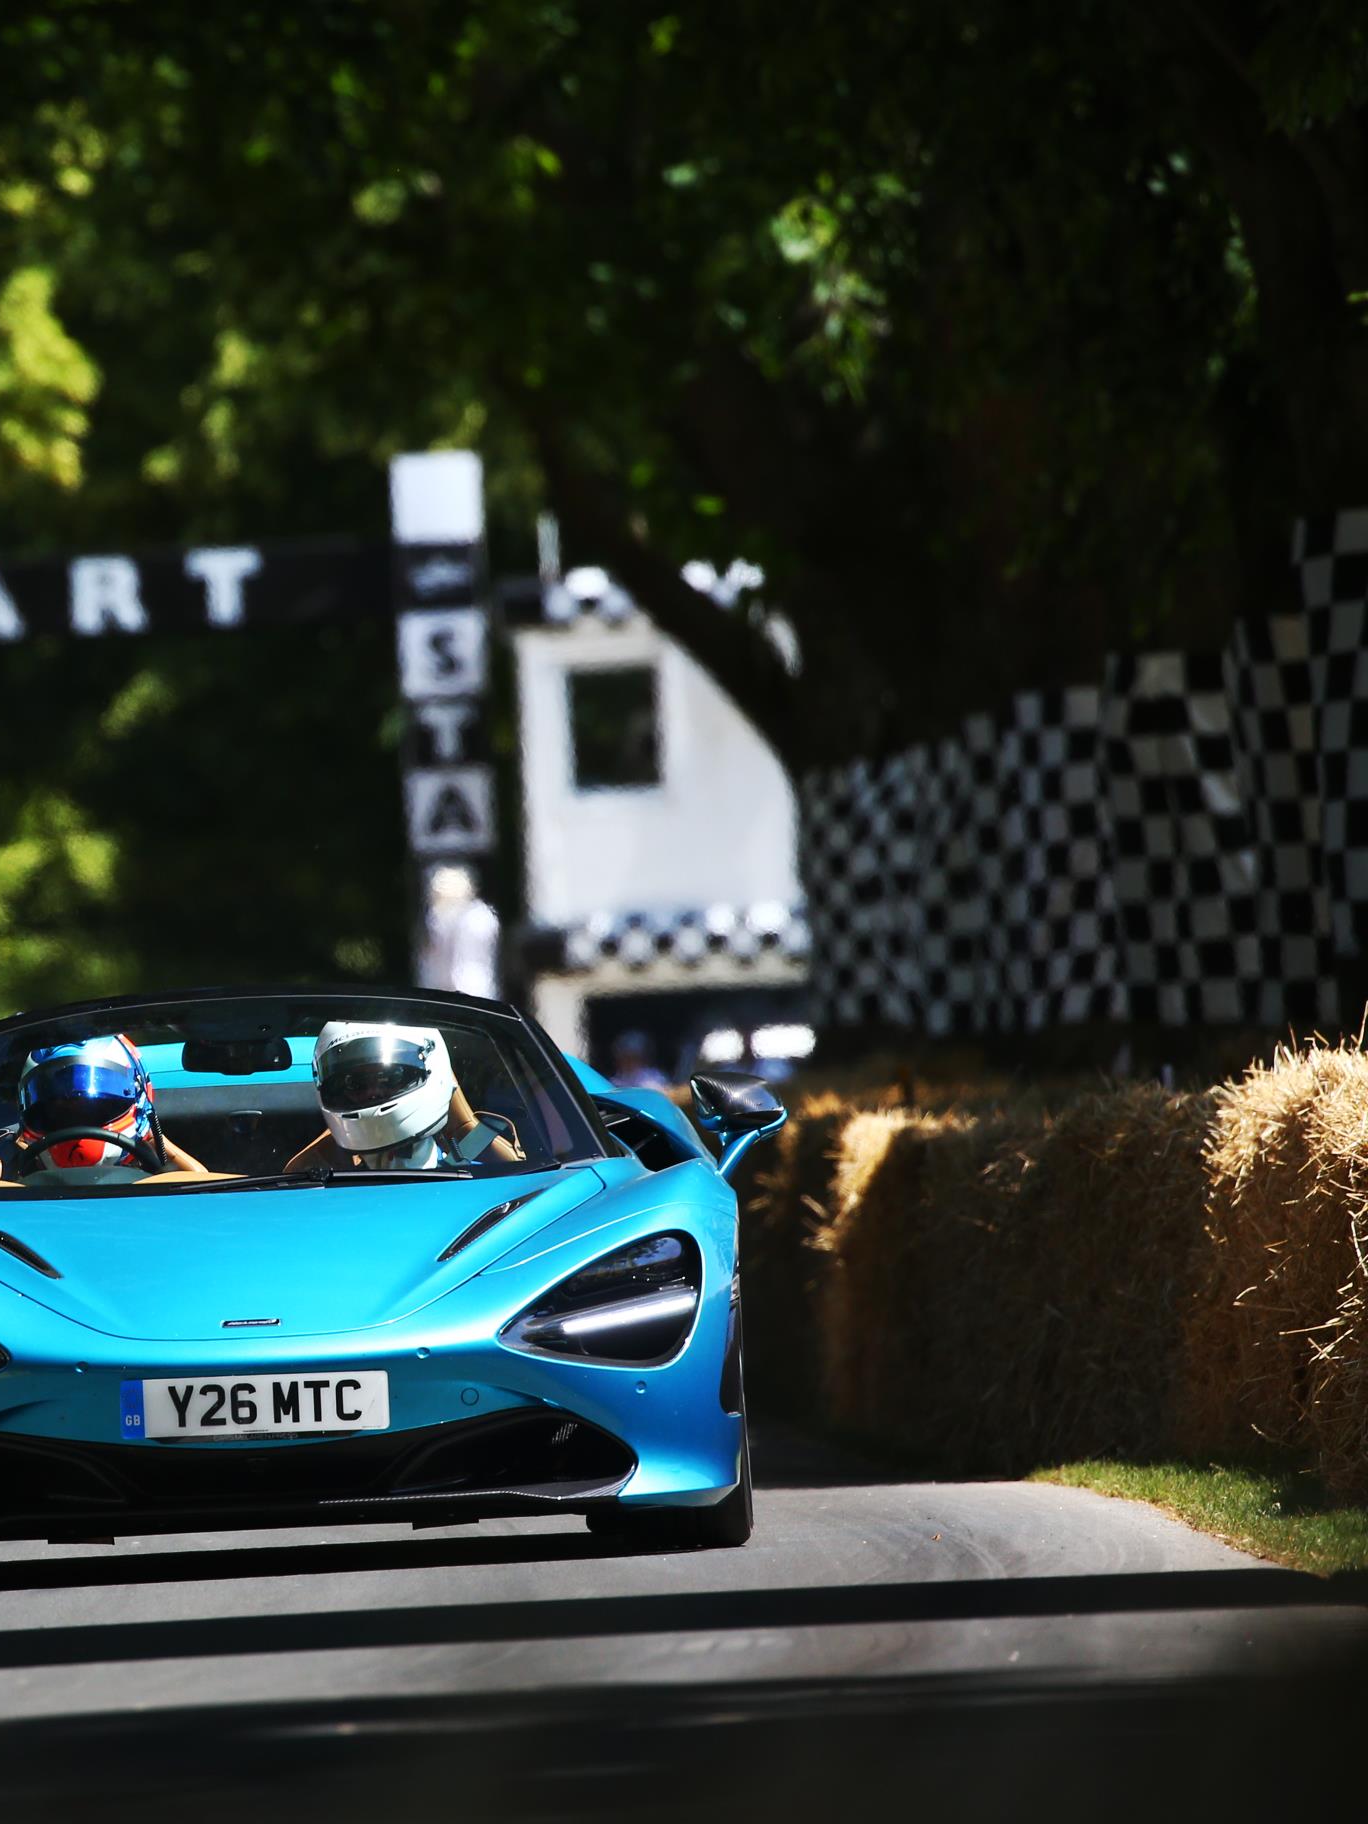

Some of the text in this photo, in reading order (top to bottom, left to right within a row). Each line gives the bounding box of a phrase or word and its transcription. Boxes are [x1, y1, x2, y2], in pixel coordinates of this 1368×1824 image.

[168, 1379, 363, 1428] Y26 MTC
[125, 1414, 141, 1426] GB
